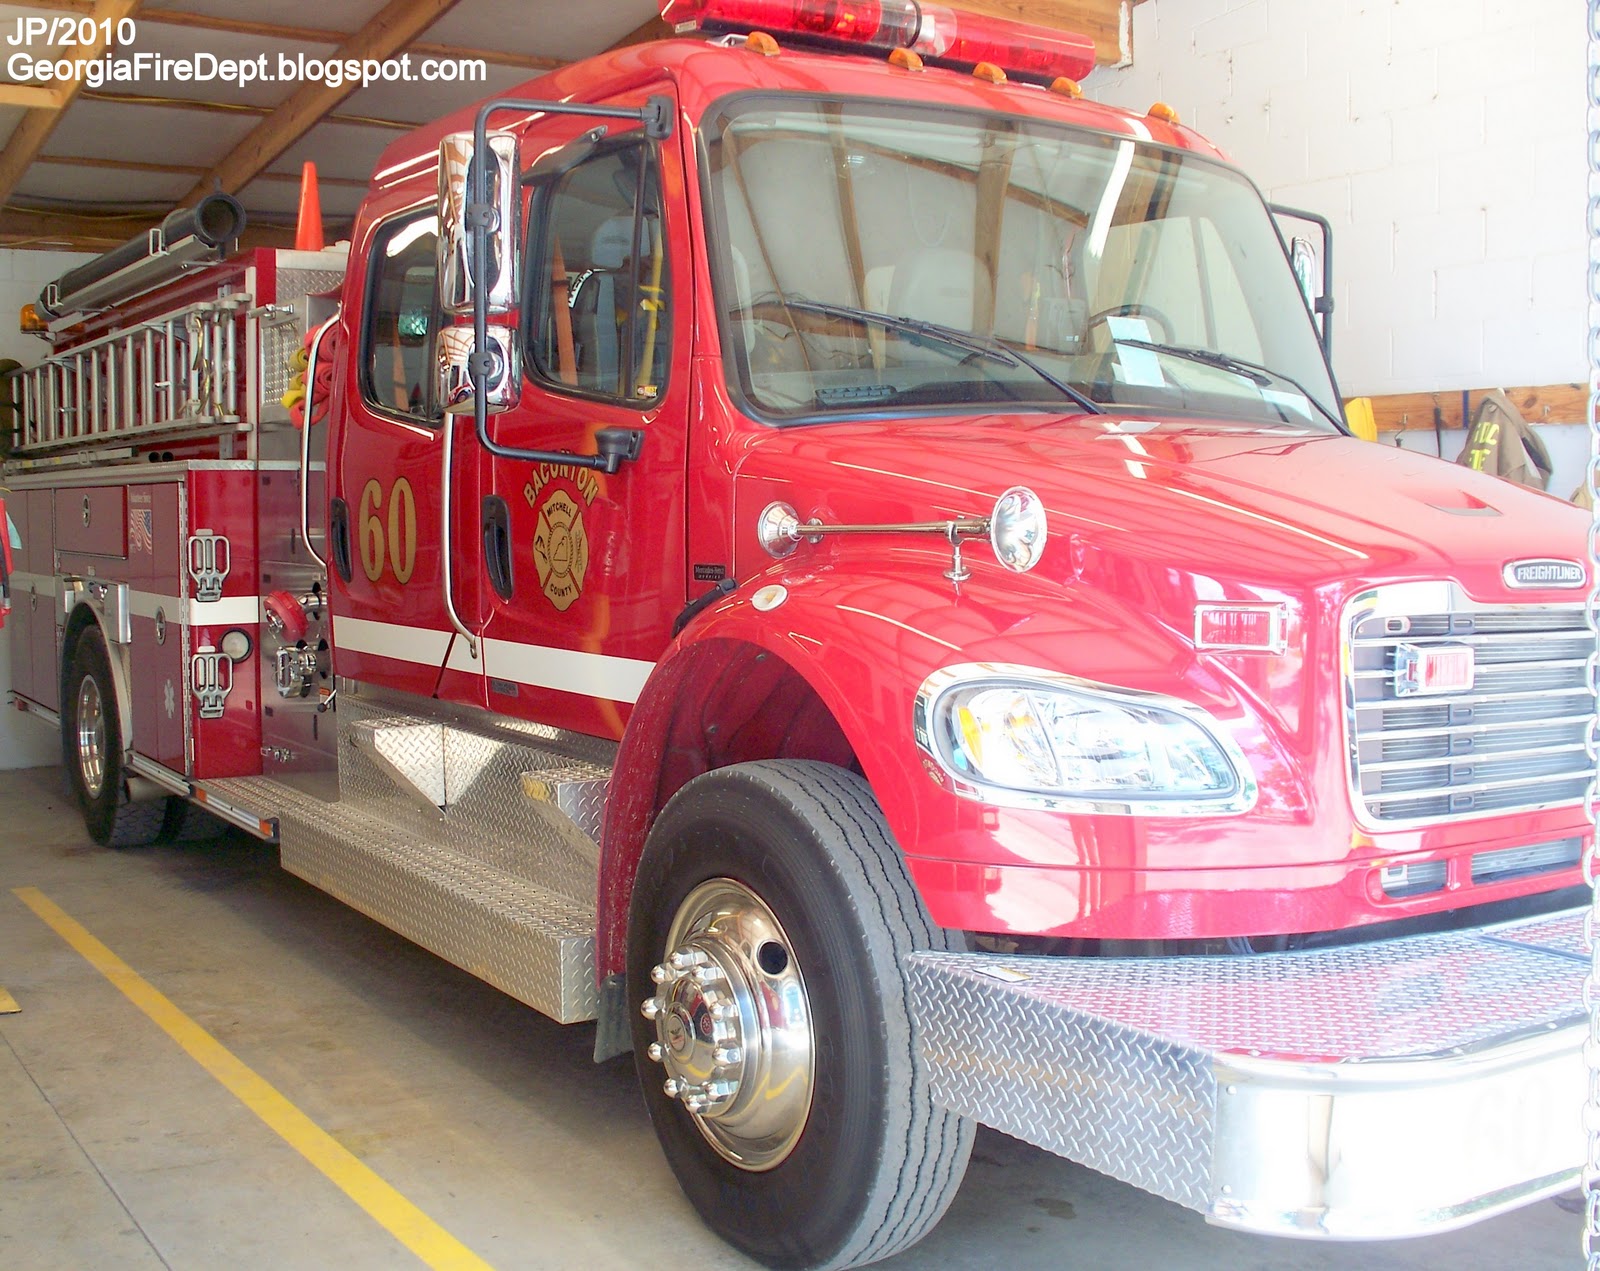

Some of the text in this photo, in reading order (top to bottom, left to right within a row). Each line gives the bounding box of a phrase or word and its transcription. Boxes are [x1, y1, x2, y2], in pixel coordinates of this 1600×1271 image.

[546, 501, 572, 518] MITCHELL
[358, 476, 416, 585] 60
[1517, 565, 1581, 580] FREIGHTLINER
[550, 583, 572, 598] COUNTY
